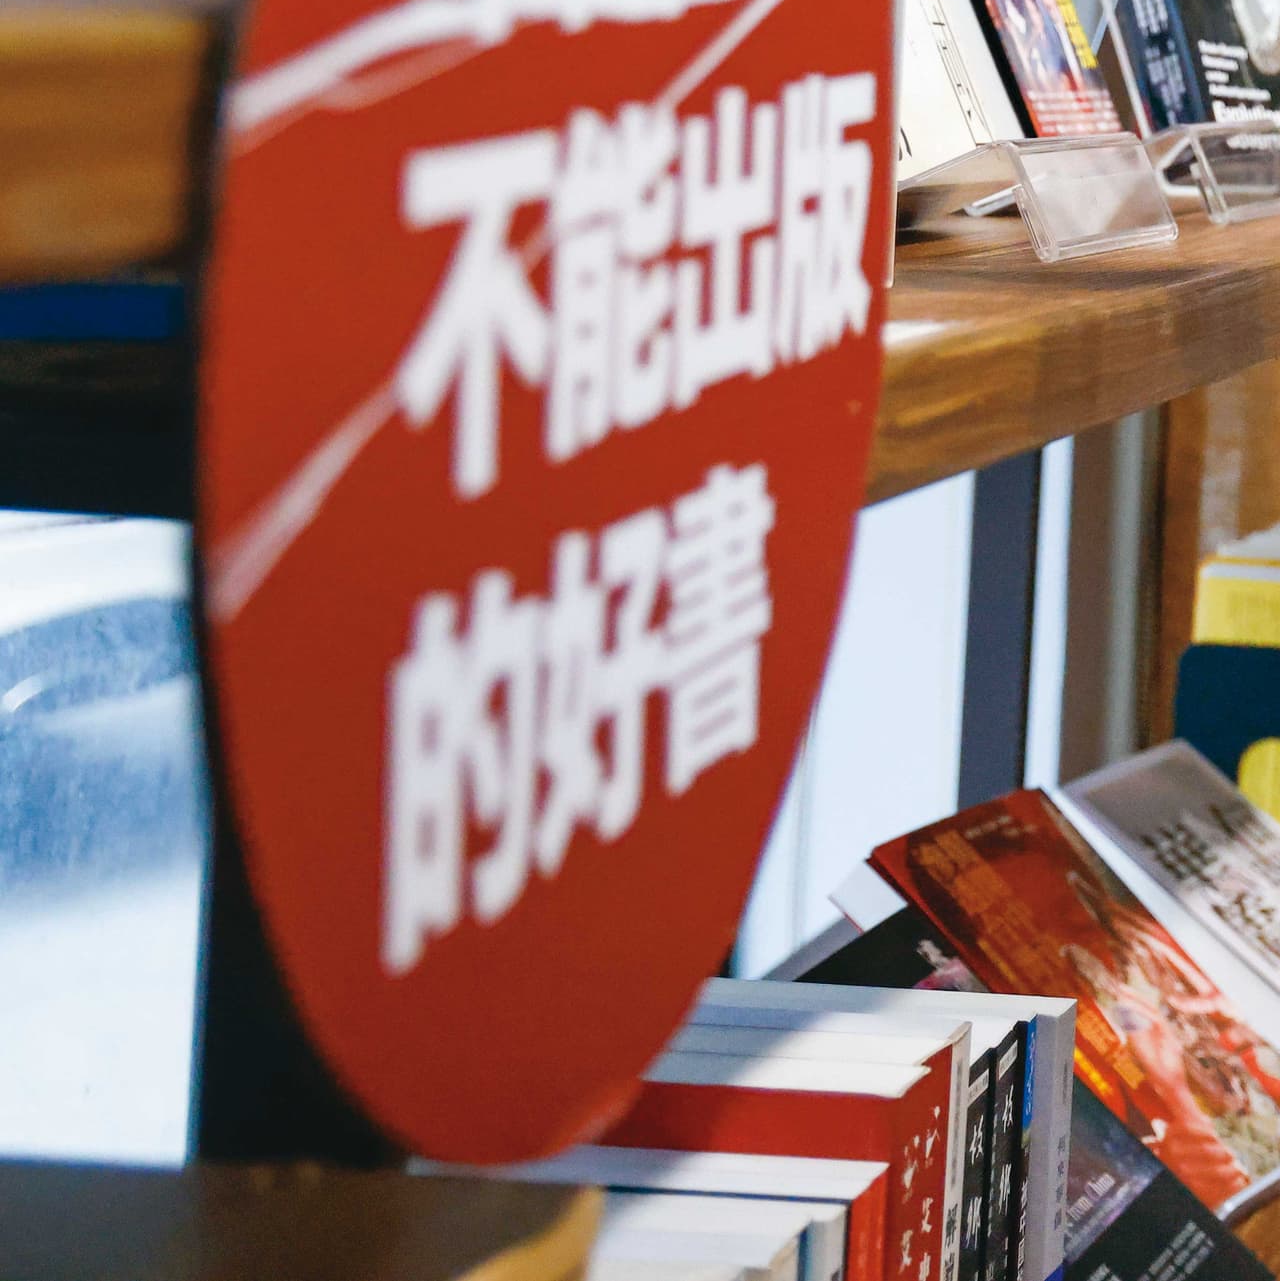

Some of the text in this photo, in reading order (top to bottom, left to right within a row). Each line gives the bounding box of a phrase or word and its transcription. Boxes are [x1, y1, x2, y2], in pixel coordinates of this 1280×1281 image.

[401, 70, 877, 500] 不能出版
[382, 462, 774, 976] 的好書
